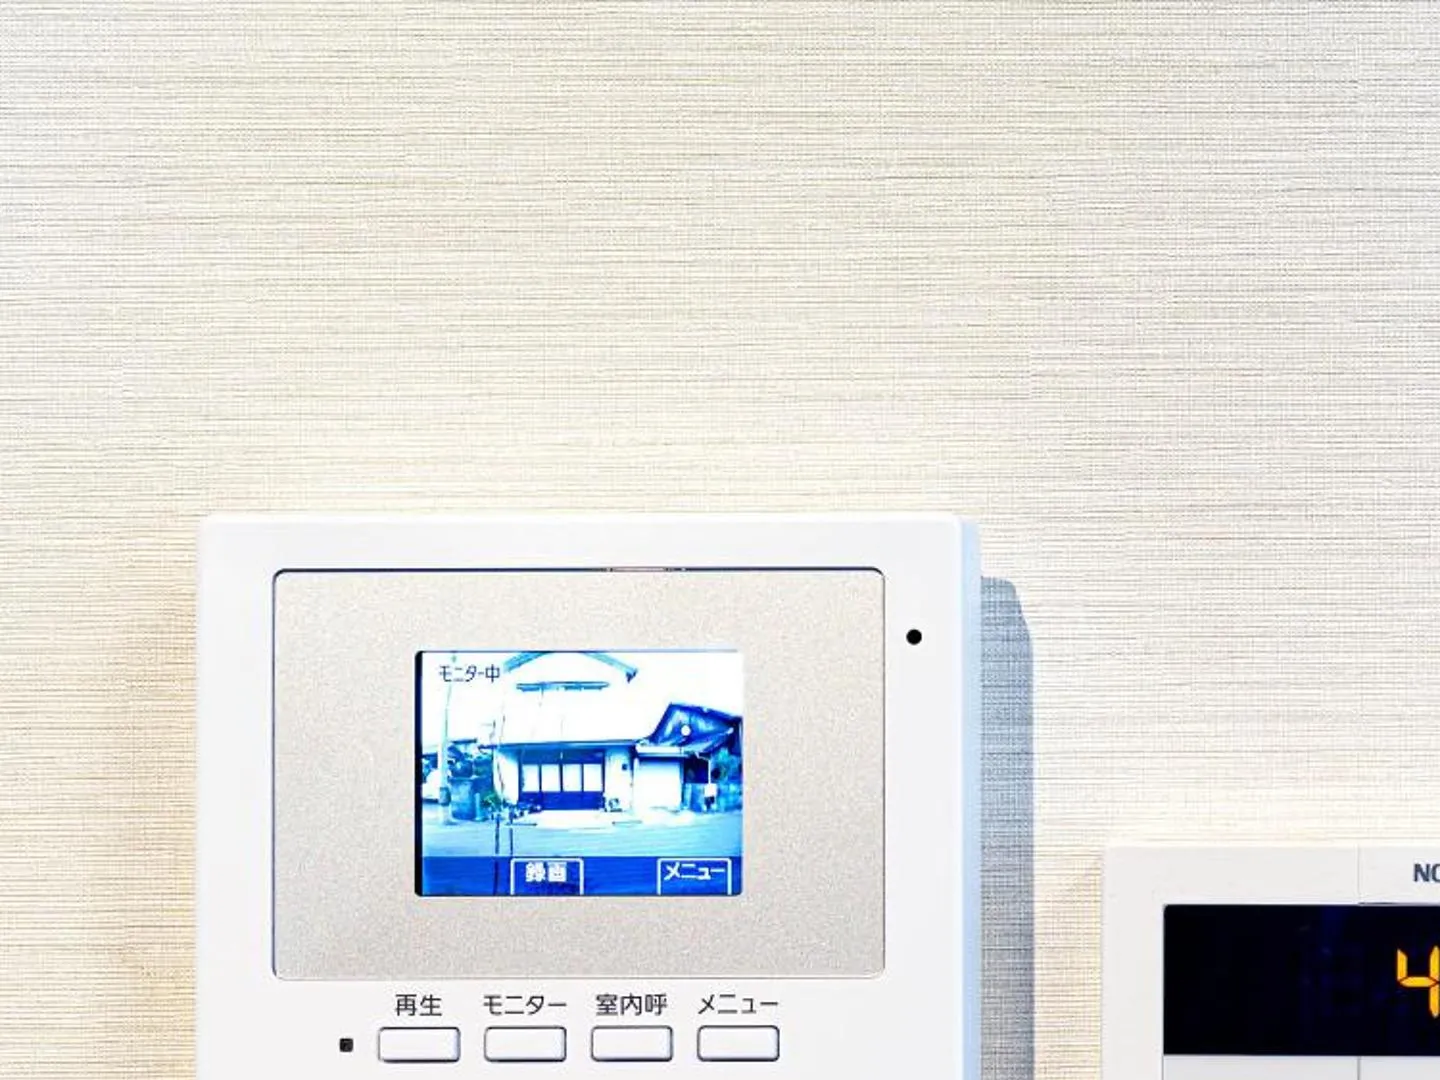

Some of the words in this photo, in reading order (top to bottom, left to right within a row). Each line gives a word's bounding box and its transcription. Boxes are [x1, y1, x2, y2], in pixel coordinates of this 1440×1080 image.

[439, 664, 500, 683] モニター中
[525, 862, 568, 882] 録画
[664, 863, 726, 880] メニュー
[394, 993, 443, 1017] 再生
[483, 995, 567, 1016] モニター
[595, 993, 668, 1017] 室内呼
[697, 993, 779, 1015] メニュー
